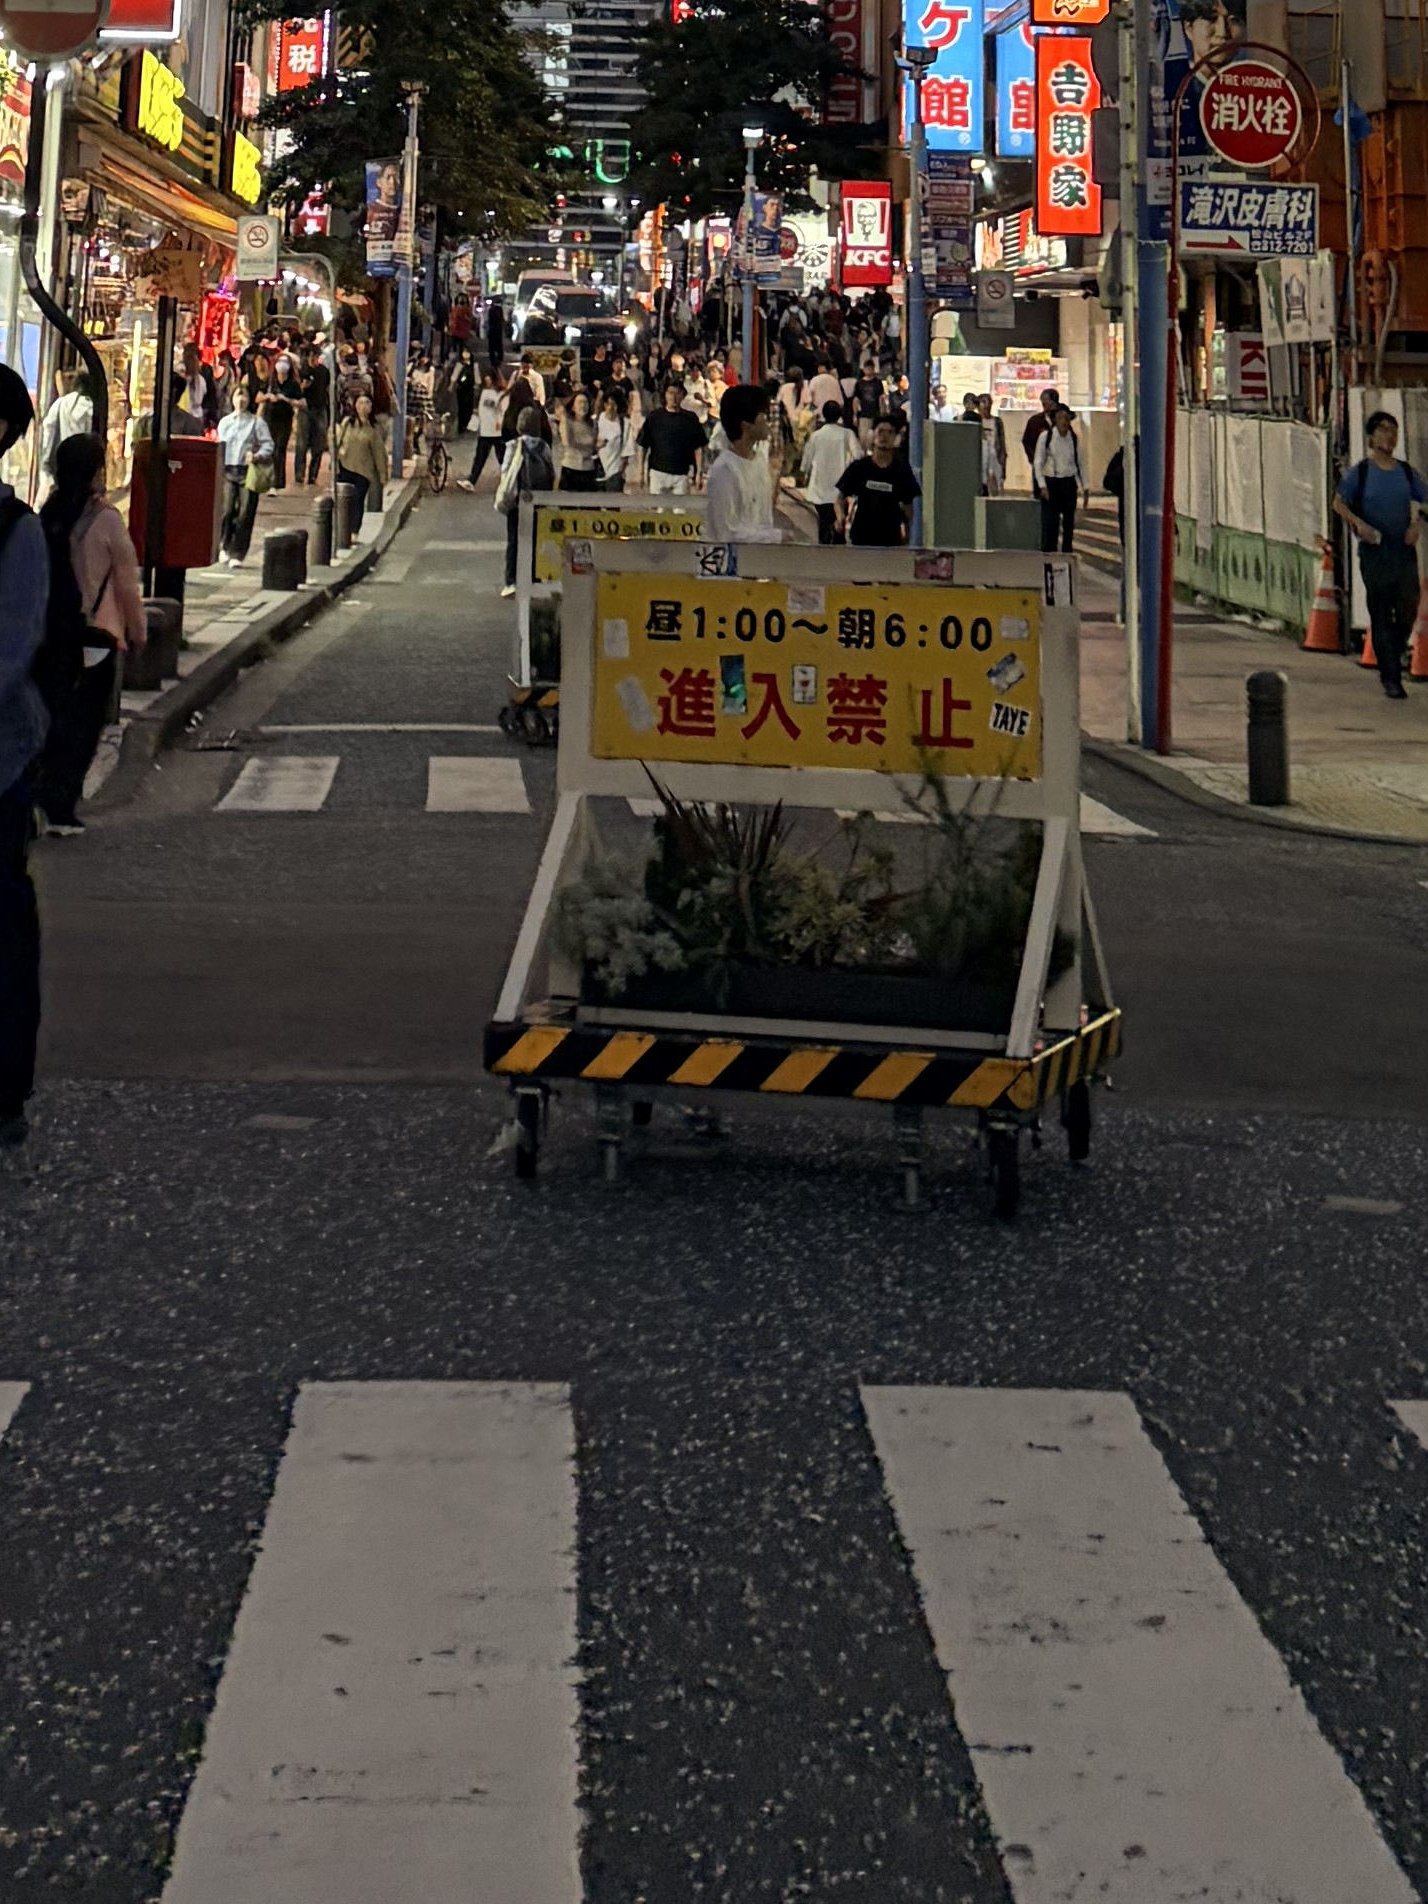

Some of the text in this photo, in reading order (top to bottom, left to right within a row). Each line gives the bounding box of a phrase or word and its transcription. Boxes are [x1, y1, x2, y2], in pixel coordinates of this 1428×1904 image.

[1051, 65, 1090, 207] 吉野家
[1211, 92, 1292, 136] 消火栓
[1185, 186, 1313, 230] 滝沢皮膚科
[844, 249, 890, 267] KFC
[657, 667, 975, 749] 進入禁止
[992, 701, 1030, 736] TAYE
